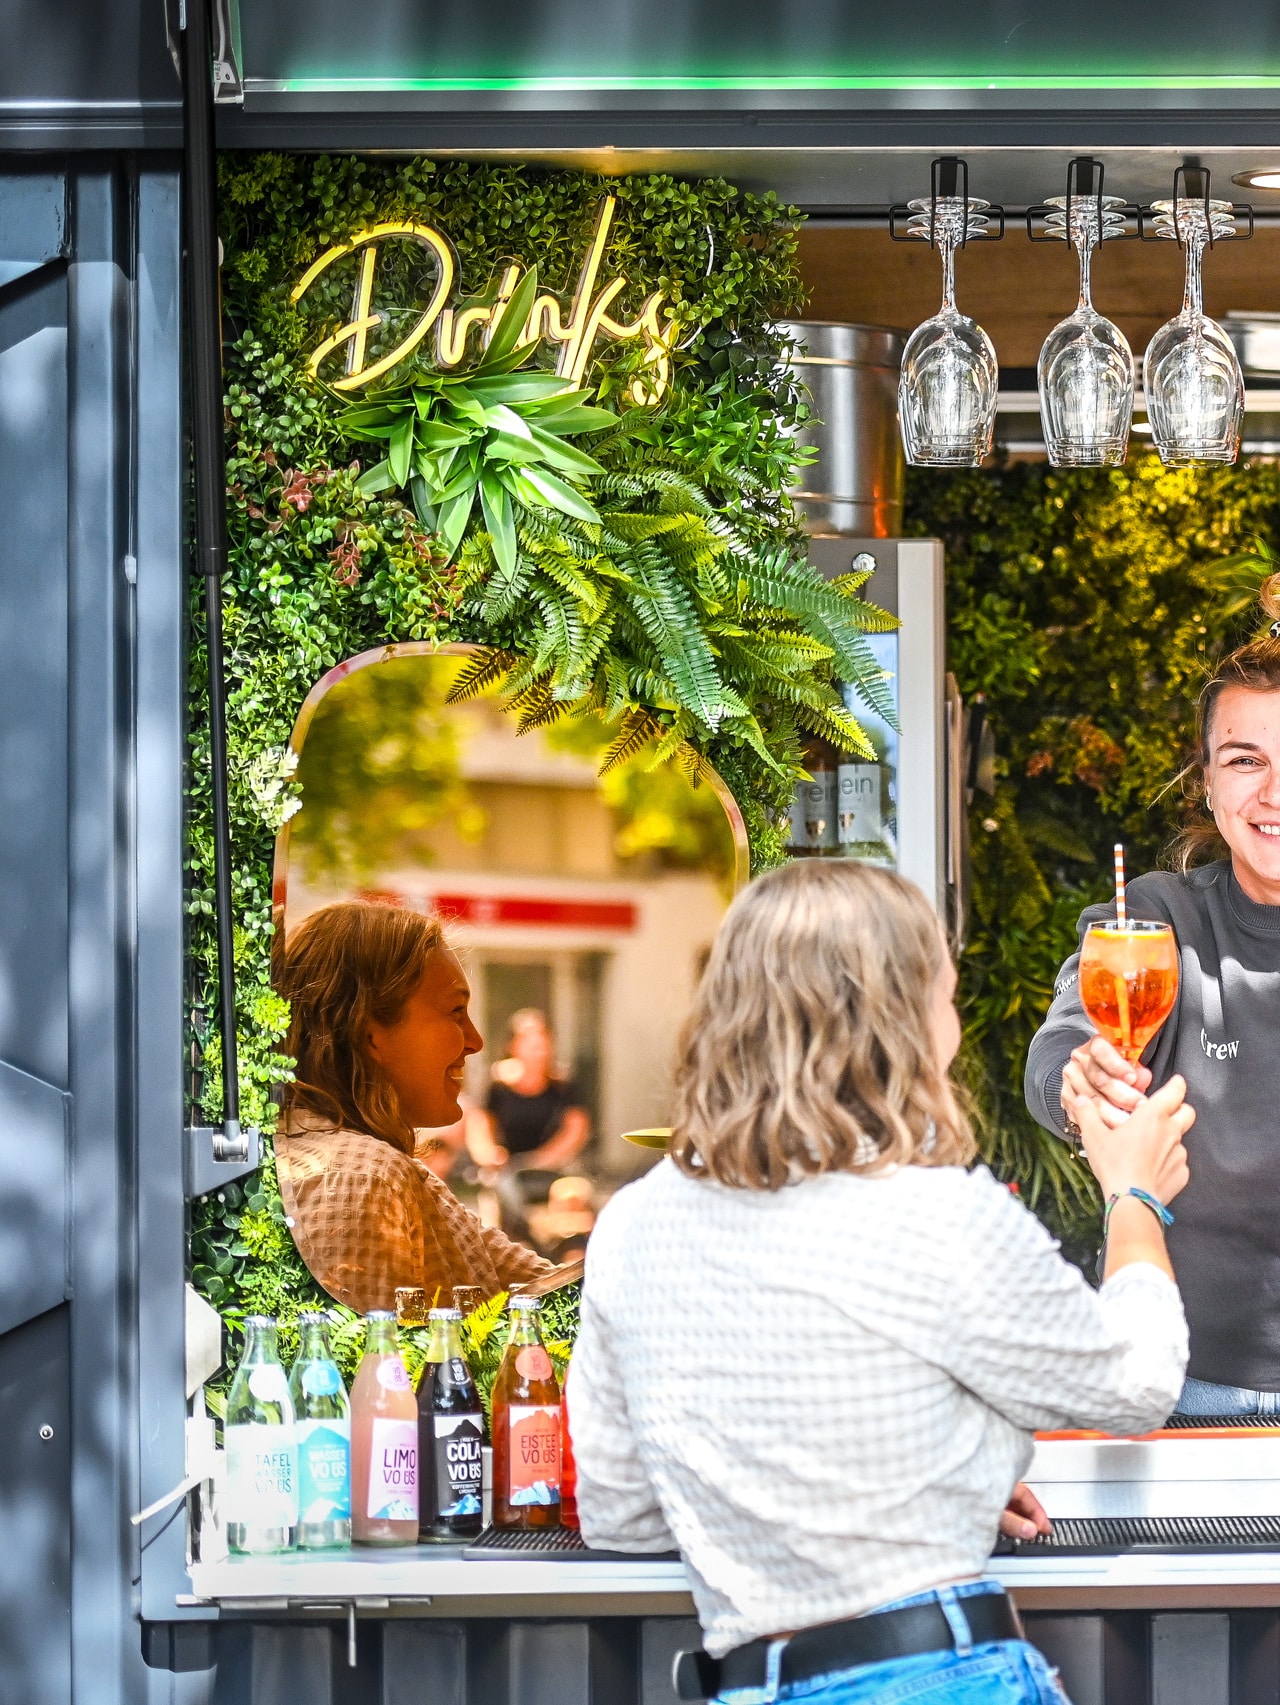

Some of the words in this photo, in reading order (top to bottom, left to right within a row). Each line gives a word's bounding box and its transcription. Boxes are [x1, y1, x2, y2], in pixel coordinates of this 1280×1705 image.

[291, 196, 669, 406] Drinks
[446, 1441, 481, 1461] COLA
[521, 1435, 556, 1449] EISTEE
[256, 1453, 291, 1467] TAFEL
[383, 1448, 416, 1469] LIMO
